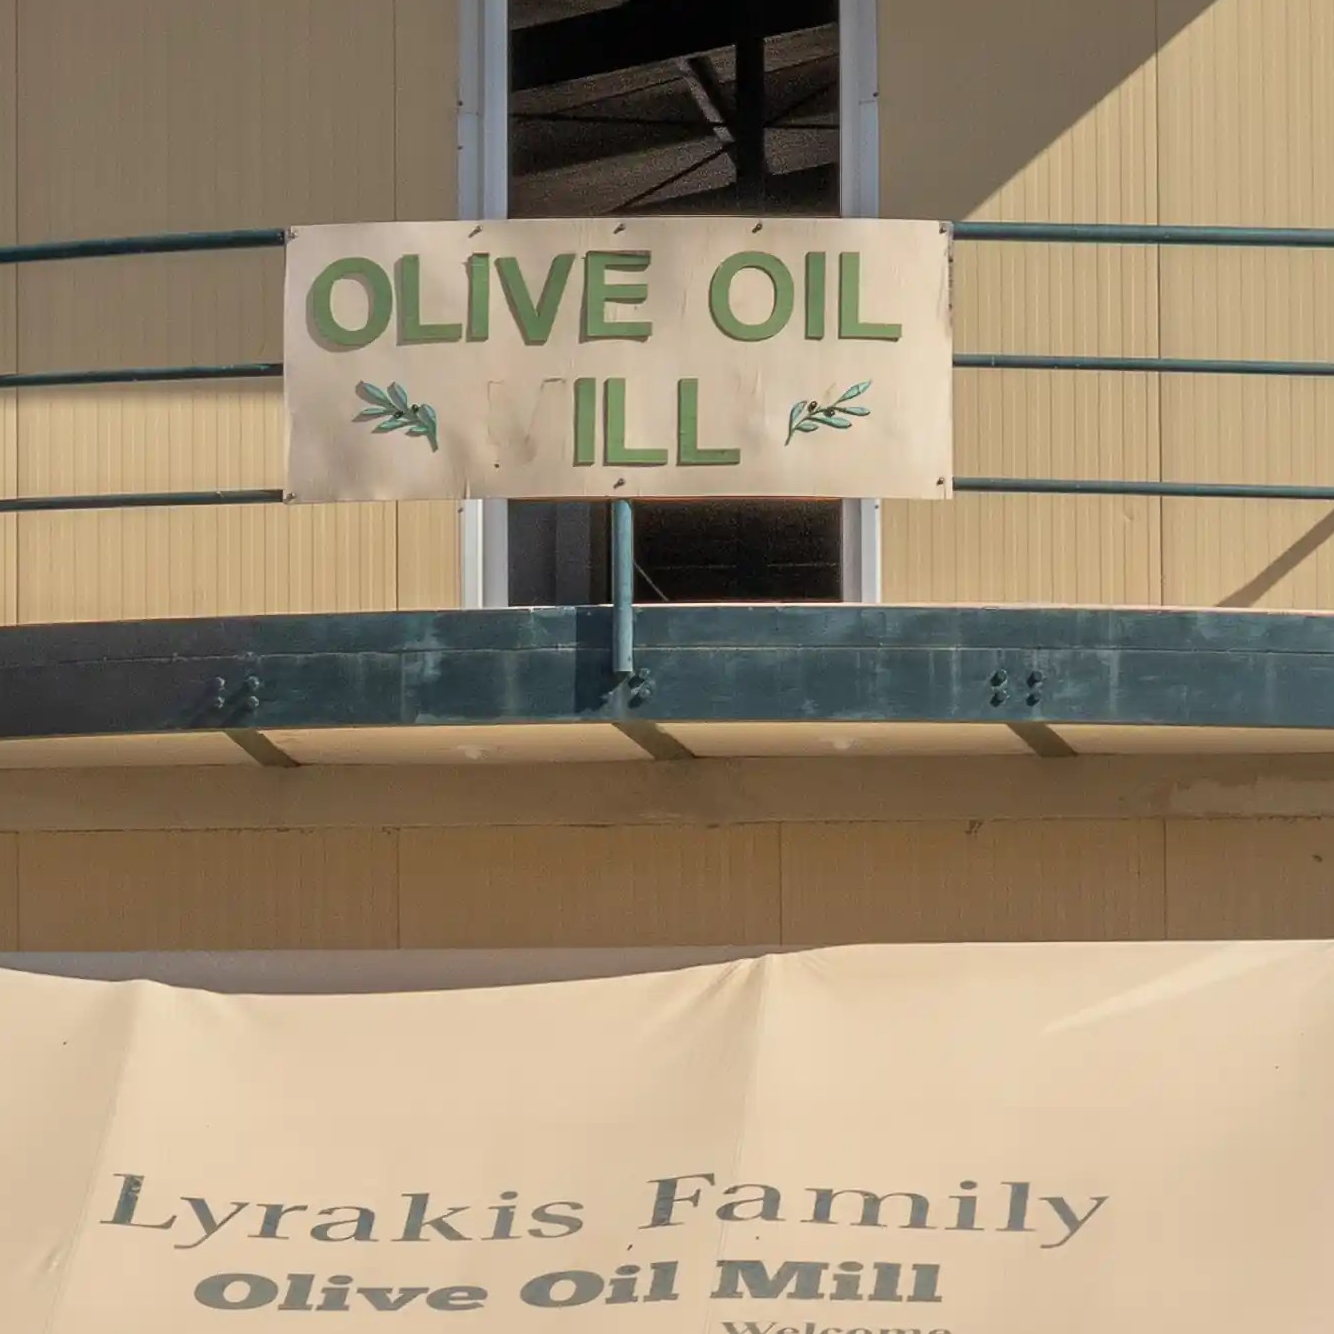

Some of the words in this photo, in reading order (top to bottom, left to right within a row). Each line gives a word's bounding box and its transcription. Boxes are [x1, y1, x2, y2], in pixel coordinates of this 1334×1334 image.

[309, 250, 653, 347] OLIVE
[709, 250, 903, 343] OIL
[573, 377, 742, 468] ILL
[99, 1173, 584, 1250] Lyrakis
[637, 1173, 1110, 1249] Family
[193, 1272, 489, 1312] Olive
[519, 1261, 679, 1309] Oil
[709, 1259, 943, 1303] Mill
